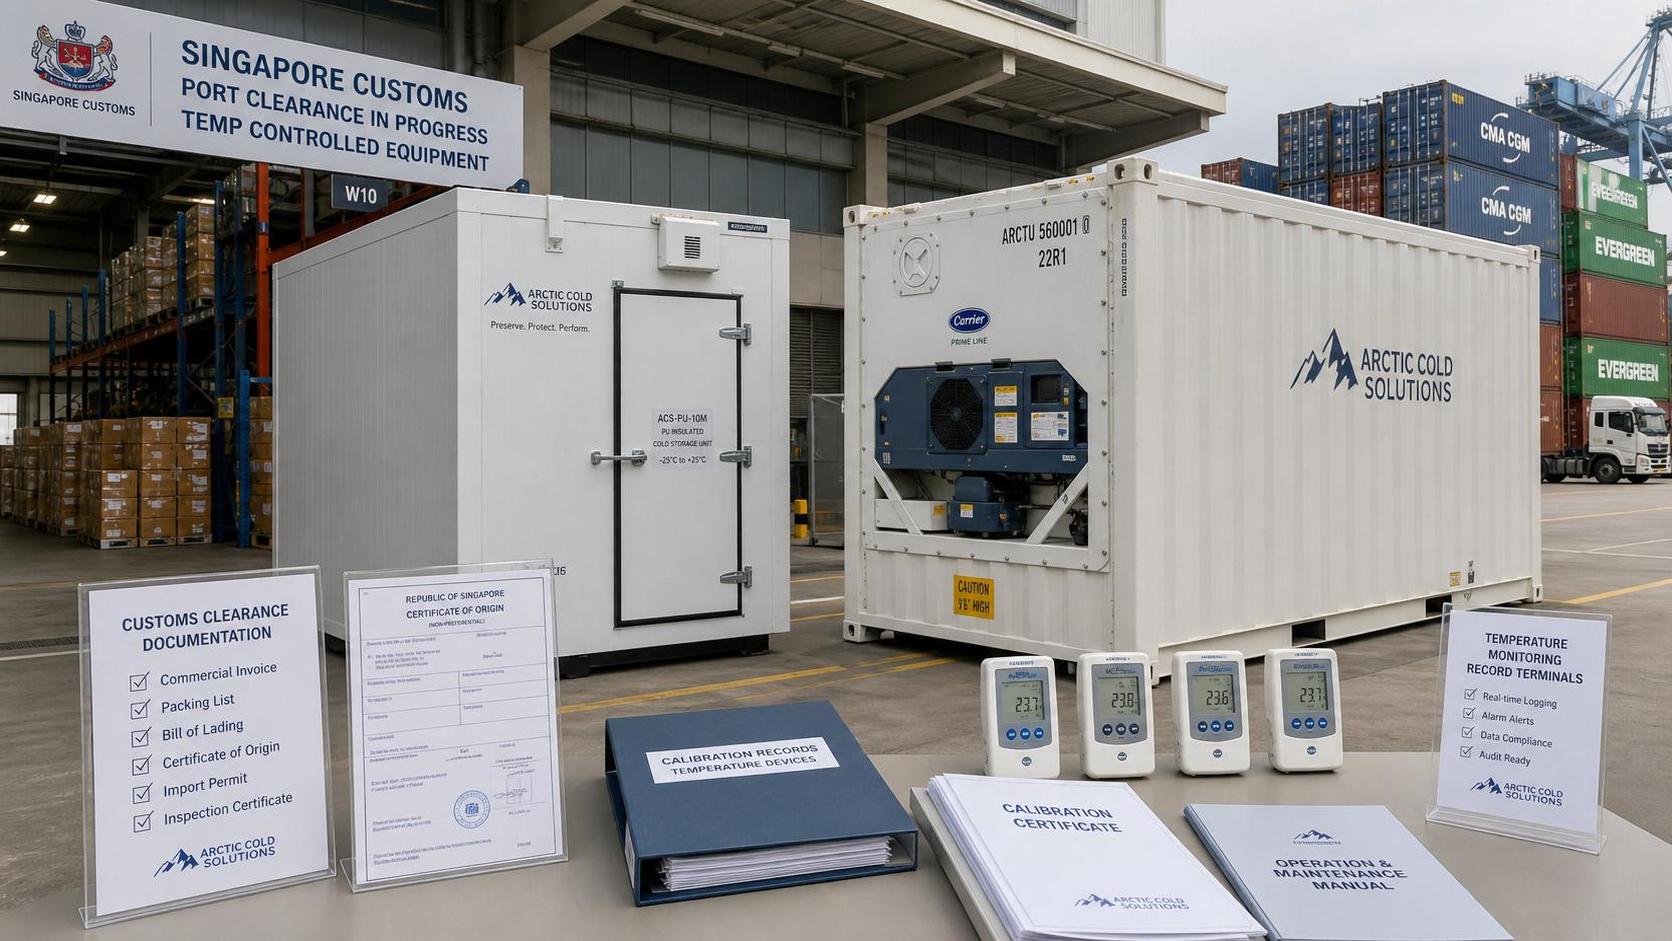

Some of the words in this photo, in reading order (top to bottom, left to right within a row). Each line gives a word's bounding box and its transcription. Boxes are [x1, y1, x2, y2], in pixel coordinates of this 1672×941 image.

[181, 40, 345, 92] SINGAPORE
[353, 72, 468, 113] CUSTOMS
[13, 89, 79, 109] SINGAPORE
[82, 99, 136, 116] CUSTOMS
[182, 78, 240, 104] PORT
[246, 89, 364, 125] CLEARANCE
[371, 110, 389, 129] IN
[396, 113, 489, 145] PROGRESS
[182, 110, 242, 136] TEMP
[250, 121, 380, 156] CONTROLLED
[387, 143, 490, 172] EQUIPMENT
[1480, 122, 1505, 146] CMA
[1508, 131, 1530, 154] CGM
[346, 186, 377, 205] W10
[1481, 197, 1506, 220] CMA
[1509, 202, 1532, 224] CGM
[1002, 223, 1035, 245] ARCTU
[1038, 218, 1078, 240] 560001
[1038, 248, 1067, 268] 22R1
[1595, 236, 1655, 267] EVERGREEN
[528, 289, 565, 301] ARCTIC
[566, 291, 593, 302] COLD
[531, 301, 593, 313] SOLUTIONS
[491, 320, 526, 331] Preserve.
[528, 322, 557, 332] Protect.
[559, 323, 590, 333] Perform.
[953, 314, 986, 327] Carrier
[973, 337, 988, 345] LINE
[1361, 348, 1413, 375] ARCTIC
[1417, 353, 1453, 377] COLD
[1598, 359, 1659, 382] EVERGREEN
[1365, 376, 1452, 403] SOLUTIONS
[658, 414, 707, 422] ACS-PU-10M
[406, 593, 446, 604] REPUBLIC
[447, 592, 458, 601] OF
[460, 589, 505, 600] SINGAPORE
[958, 580, 990, 595] CAUTION
[406, 607, 460, 619] CERTIFICATE
[462, 606, 473, 615] OF
[475, 604, 504, 614] ORIGIN
[973, 599, 990, 614] HIGH
[122, 612, 198, 632] CUSTOMS
[203, 603, 289, 624] CLEARANCE
[143, 625, 272, 652] DOCUMENTATION
[1485, 633, 1568, 650] TEMPERATURE
[1488, 650, 1562, 666] MONITORING
[160, 666, 233, 687] Commercial
[236, 661, 278, 677] Invoice
[1467, 663, 1513, 678] RECORD
[1516, 668, 1584, 685] TERMINALS
[161, 696, 210, 714] Packing
[213, 694, 235, 707] List
[1111, 692, 1135, 708] 23.8
[1206, 690, 1229, 706] 23.6
[1300, 687, 1322, 703] 23.7
[1483, 692, 1522, 704] Real-time
[1524, 696, 1558, 710] Logging
[1015, 697, 1038, 713] 23.7
[1482, 712, 1507, 723] Alarm
[1509, 715, 1534, 726] Alerts
[162, 728, 183, 742] Bill
[186, 725, 199, 738] of
[203, 720, 244, 736] Lading
[1481, 731, 1500, 741] Data
[1502, 733, 1553, 748] Compliance
[163, 750, 226, 770] Certificate
[230, 746, 242, 759] of
[245, 741, 281, 757] Origin
[661, 750, 753, 766] CALIBRATION
[756, 744, 818, 756] RECORDS
[1479, 750, 1502, 762] Audit
[1504, 753, 1531, 768] Ready
[670, 761, 763, 776] TEMPERATURE
[766, 755, 817, 767] DEVICES
[163, 781, 206, 798] Import
[209, 772, 248, 788] Permit
[1503, 782, 1537, 794] ARCTIC
[1538, 787, 1564, 798] COLD
[1505, 791, 1563, 807] SOLUTIONS
[164, 803, 229, 826] Inspection
[233, 792, 294, 813] Certificate
[1002, 803, 1113, 819] CALIBRATION
[1013, 818, 1122, 833] CERTIFICATE
[200, 842, 242, 858] ARCTIC
[244, 835, 276, 850] COLD
[204, 845, 276, 868] SOLUTIONS
[1275, 859, 1375, 868] OPERATION
[1379, 859, 1393, 868] &
[1273, 869, 1408, 878] MAINTENANCE
[1311, 881, 1395, 890] MANUAL
[1114, 896, 1153, 904] ARCTIC
[1120, 902, 1190, 910] SOLUTIONS
